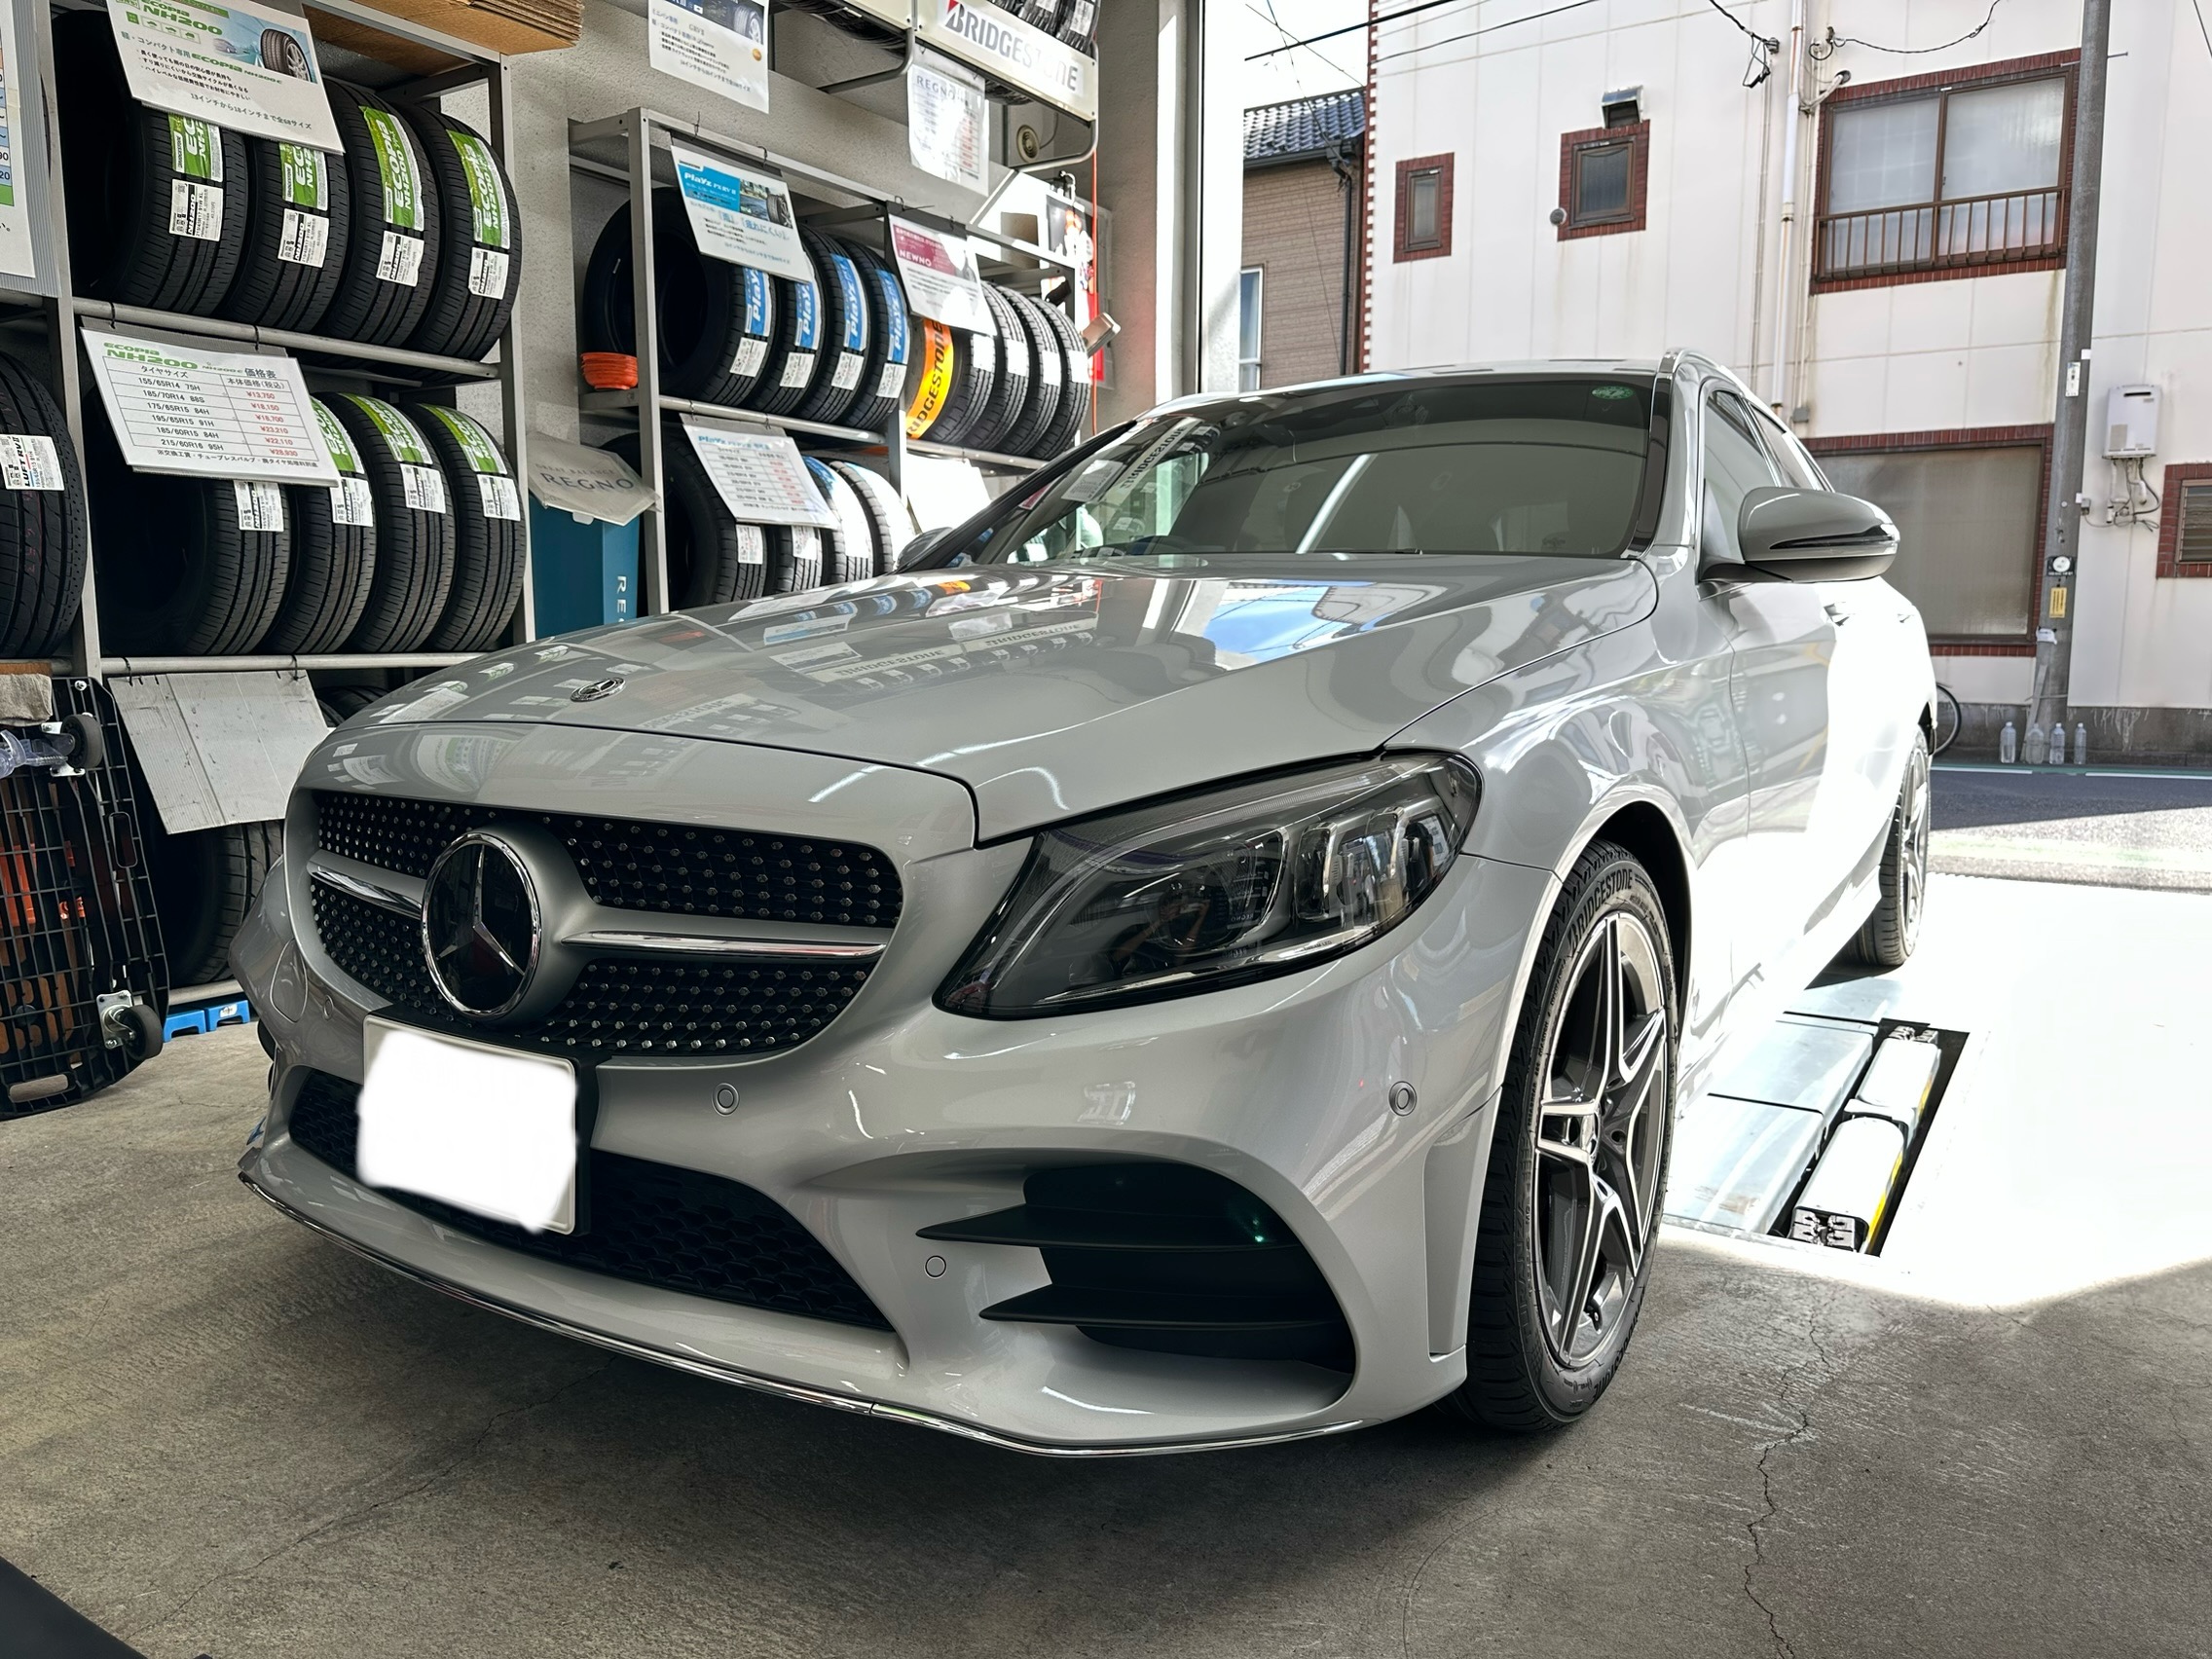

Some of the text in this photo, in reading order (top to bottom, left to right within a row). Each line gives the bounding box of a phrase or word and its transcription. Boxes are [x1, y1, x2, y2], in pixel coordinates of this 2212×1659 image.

[143, 5, 223, 36] NH200
[944, 1, 1079, 92] BRIDGESTNE
[916, 75, 955, 101] REGNO
[899, 249, 932, 267] NEWNO
[801, 284, 811, 335] Play
[106, 349, 198, 369] NH200
[244, 367, 276, 379] 価格表
[140, 365, 189, 379] タイヤサイズ
[138, 377, 180, 389] 155/65R14
[906, 320, 945, 437] RIDGESTONE
[143, 389, 185, 402] 185/70R14
[147, 401, 190, 414] 175/65R15
[152, 414, 195, 426] 195/65R15
[157, 426, 199, 438] 185/60R15
[161, 438, 203, 450] 215/60R16
[540, 472, 634, 491] REGNO
[616, 575, 627, 623] RE
[1568, 868, 1633, 951] BRIDGESTONE
